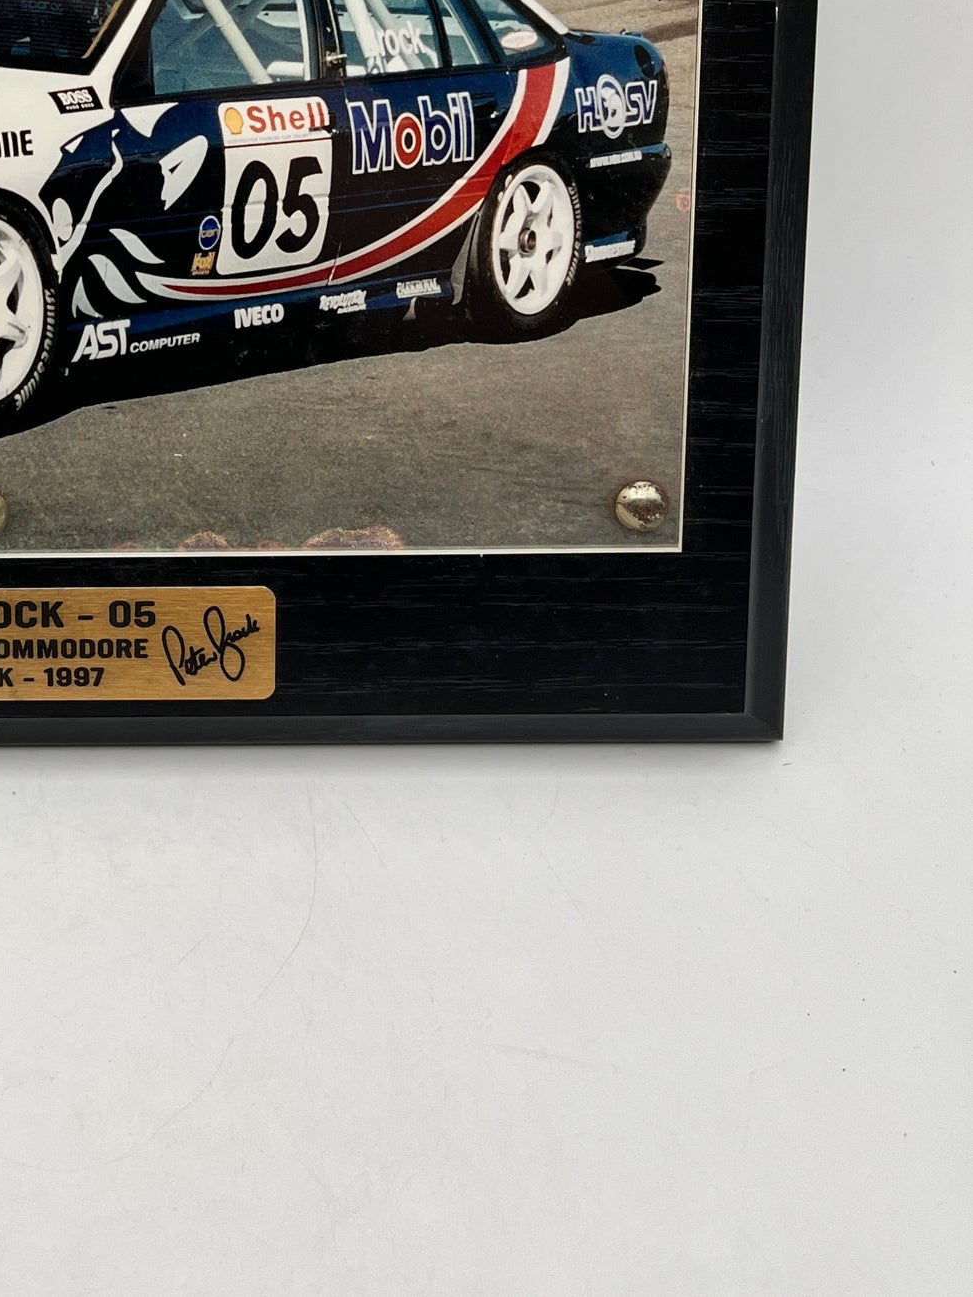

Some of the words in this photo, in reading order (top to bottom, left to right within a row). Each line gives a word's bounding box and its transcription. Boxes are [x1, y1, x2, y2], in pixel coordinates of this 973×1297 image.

[57, 89, 93, 106] BOSS
[246, 102, 326, 134] Shell
[347, 91, 475, 175] Mobil
[231, 156, 323, 259] 05
[234, 303, 285, 329] IVECO
[71, 319, 131, 363] AST
[130, 333, 200, 354] COMPUTER
[108, 600, 156, 628] 05
[43, 667, 105, 687] 1997
